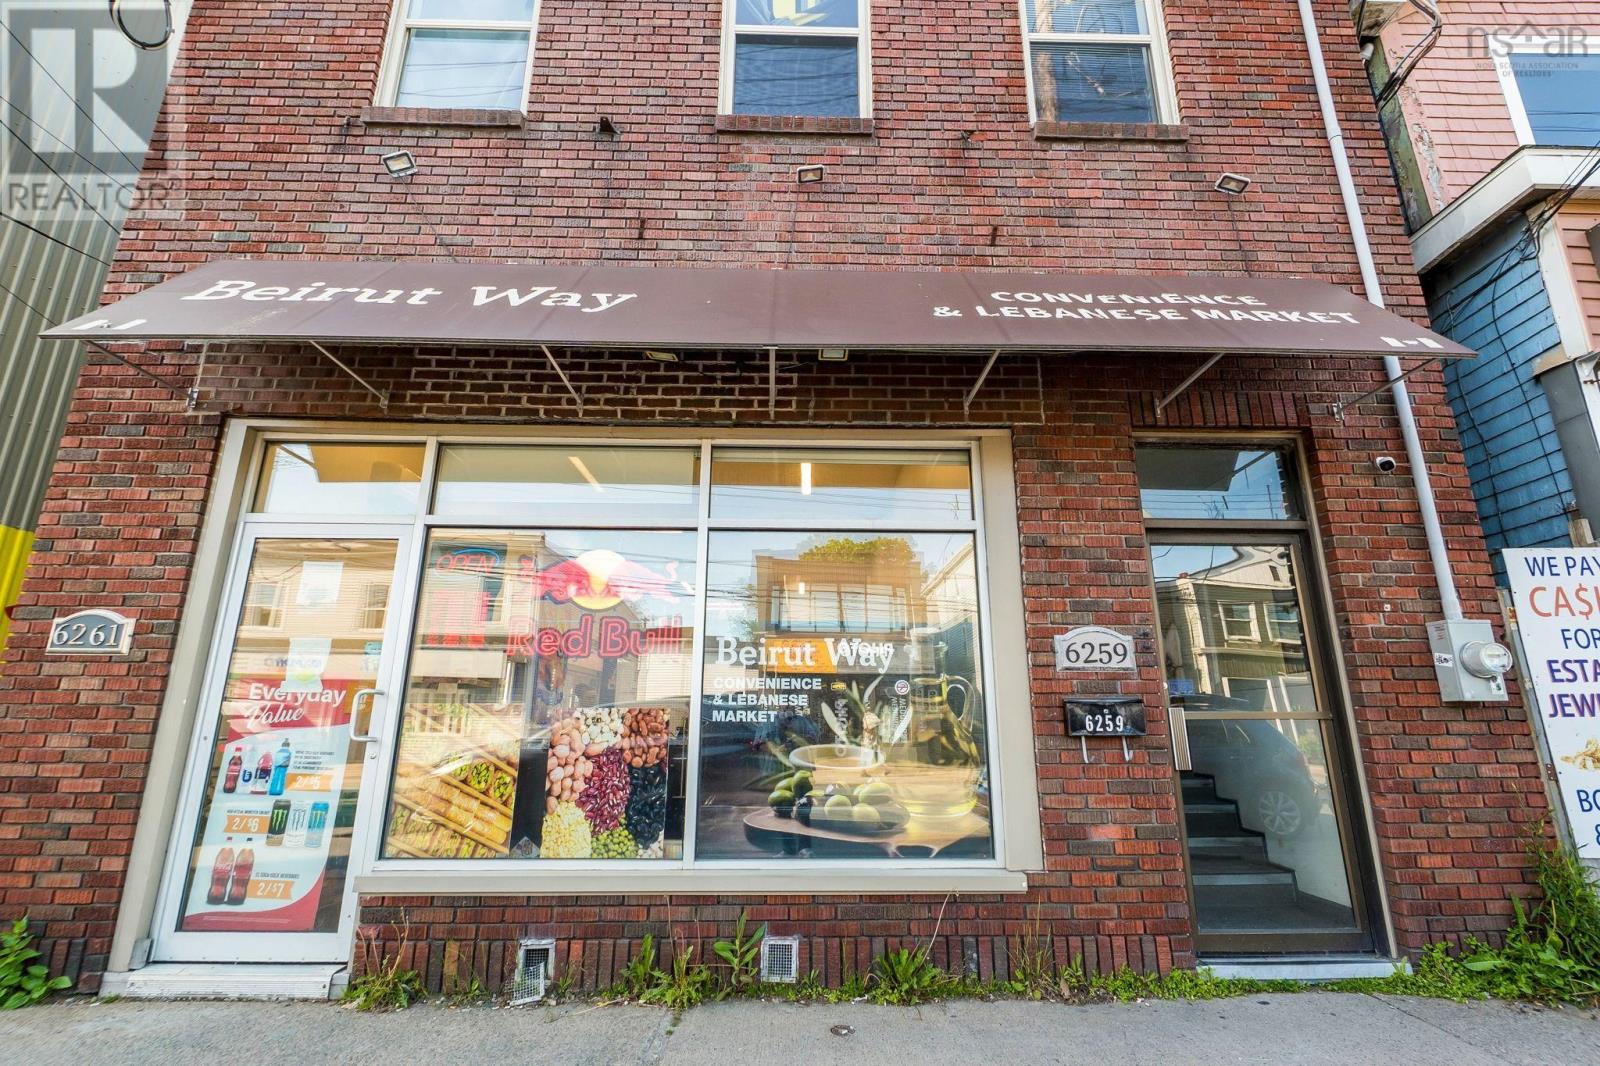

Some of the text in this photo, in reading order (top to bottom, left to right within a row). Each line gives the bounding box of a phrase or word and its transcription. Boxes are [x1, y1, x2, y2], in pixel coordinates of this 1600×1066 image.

[181, 280, 637, 313] Beirut Way
[990, 291, 1268, 307] CONVENIENCE
[932, 305, 1360, 325] & LEBANESE MARKET
[436, 553, 496, 575] OPEN
[1524, 556, 1560, 577] WE
[53, 623, 119, 646] 6261
[506, 614, 594, 659] Red
[600, 614, 683, 659] Bull
[715, 636, 894, 674] Beirut Way
[1065, 642, 1128, 664] 6259
[712, 678, 822, 690] CONVENIENCE
[248, 683, 346, 708] Everyday
[713, 694, 808, 706] & LEBANESE
[1549, 693, 1600, 718] JEW
[244, 703, 305, 729] Value
[712, 710, 778, 723] MARKET
[1085, 714, 1124, 732] 6259
[256, 881, 285, 898] 2/$7
